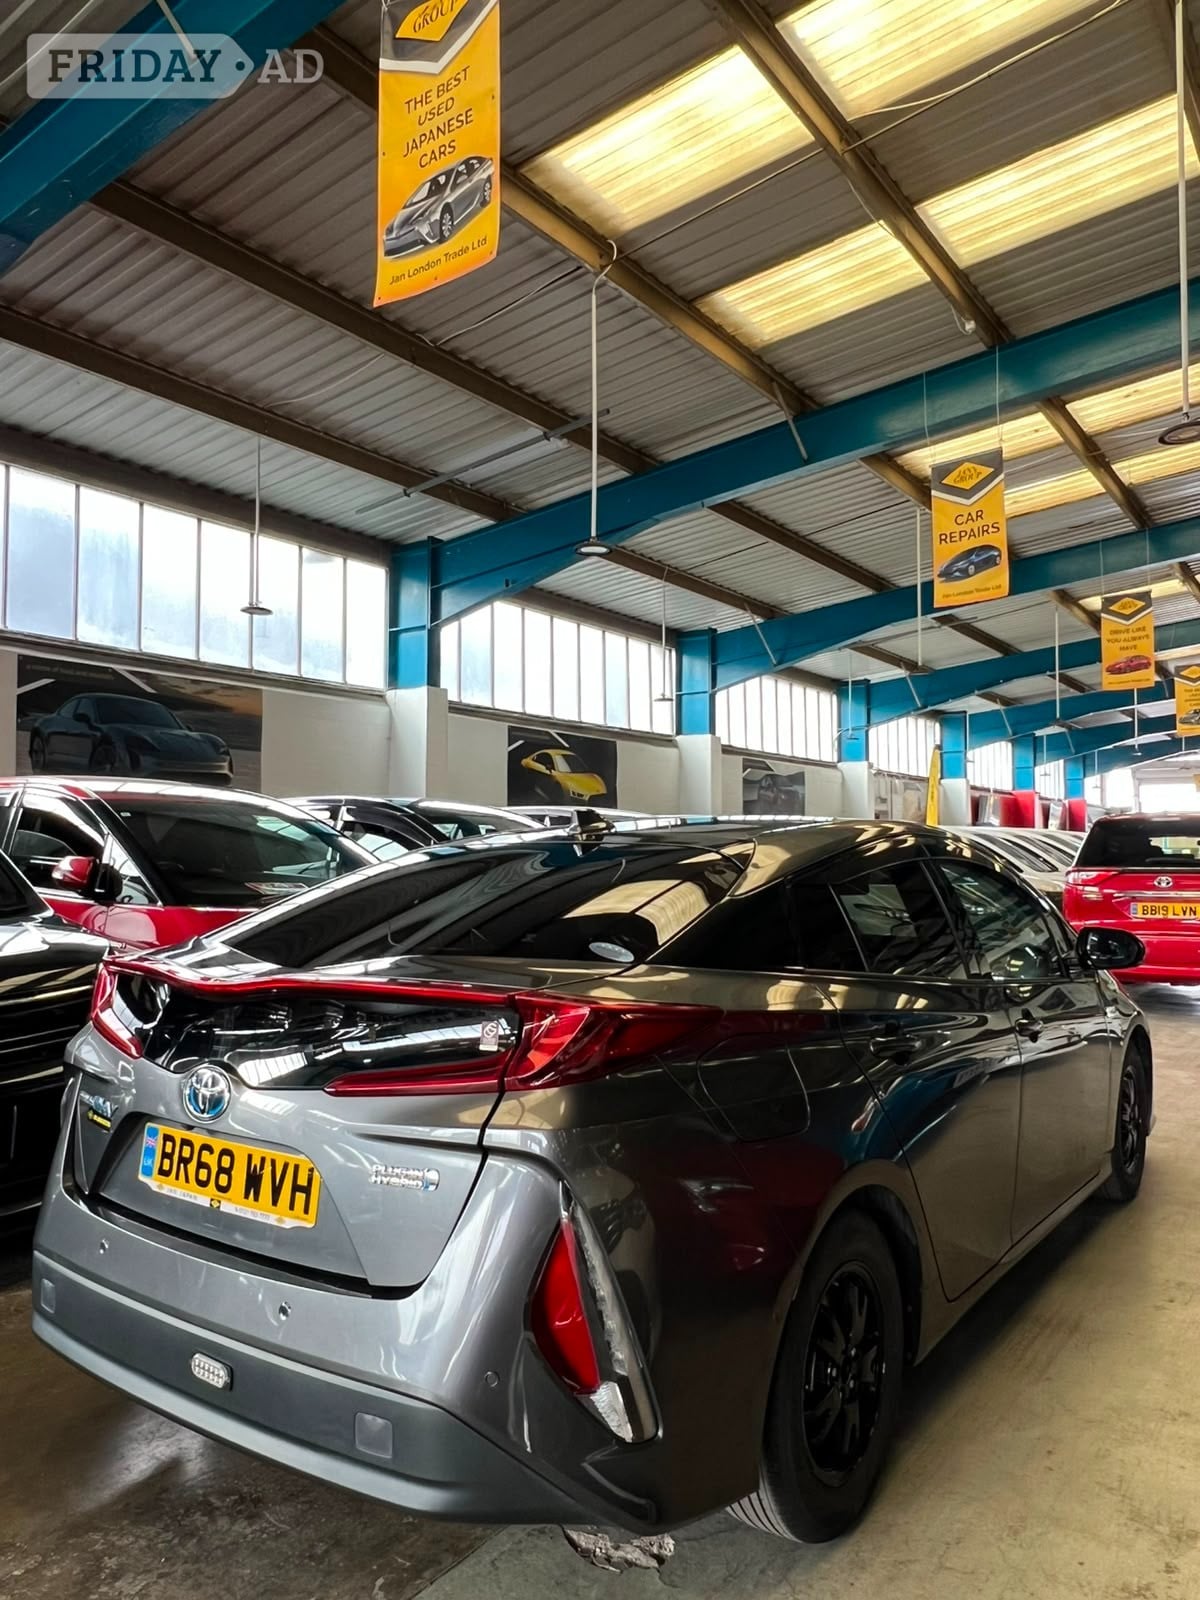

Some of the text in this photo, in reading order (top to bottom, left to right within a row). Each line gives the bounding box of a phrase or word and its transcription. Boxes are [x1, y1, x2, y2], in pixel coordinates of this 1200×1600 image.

[404, 65, 471, 114] THE BEST
[418, 97, 455, 126] USED
[403, 108, 474, 158] JAPANESE
[419, 140, 456, 169] CARS
[389, 236, 488, 285] Jan London Trade Ltd
[954, 509, 984, 526] CAR
[938, 522, 1001, 545] REPAIRS
[1142, 904, 1197, 917] BB19 LVN
[157, 1133, 315, 1215] BR68 WVH
